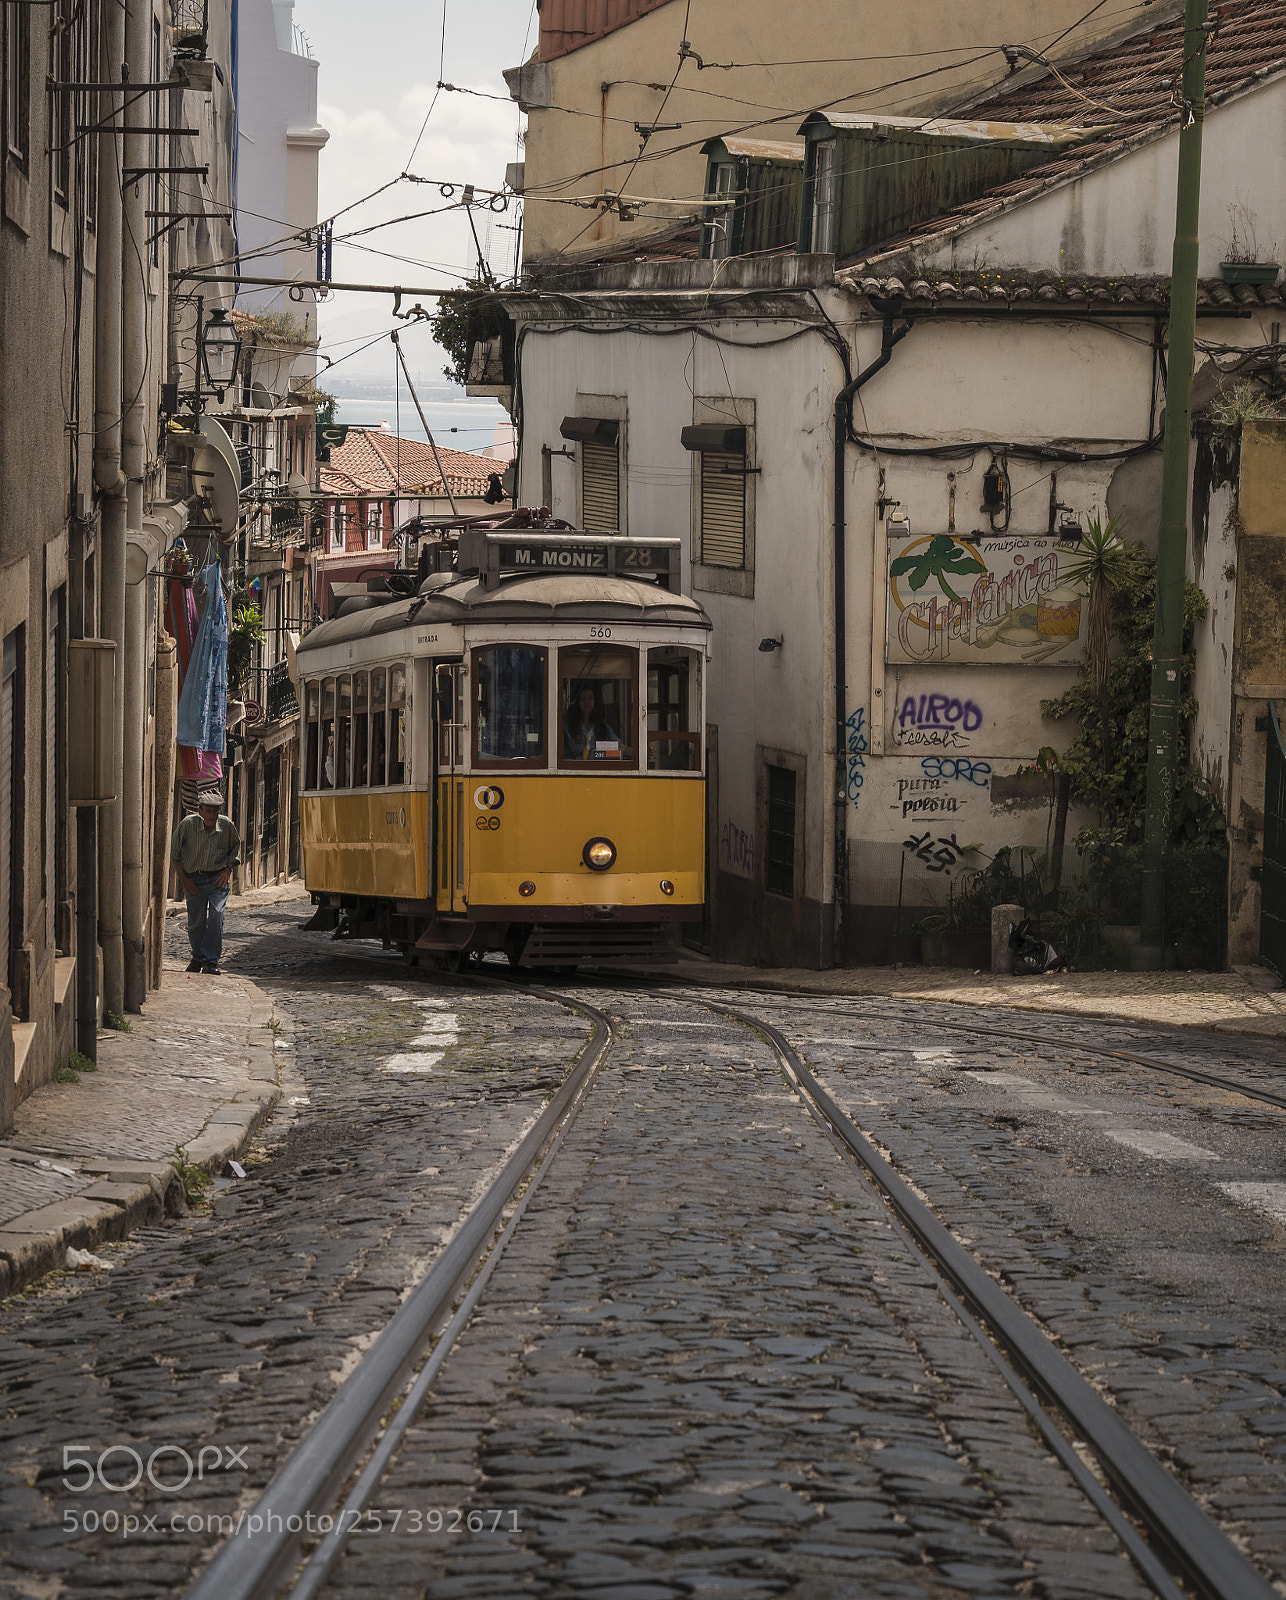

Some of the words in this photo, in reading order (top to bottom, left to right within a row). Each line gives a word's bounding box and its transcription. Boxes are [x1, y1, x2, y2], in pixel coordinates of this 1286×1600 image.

[1034, 539, 1047, 547] ao
[515, 549, 536, 564] M.
[542, 551, 604, 567] MONIZ
[624, 548, 651, 566] 28
[590, 627, 612, 638] 560
[417, 634, 439, 644] ENTRADA
